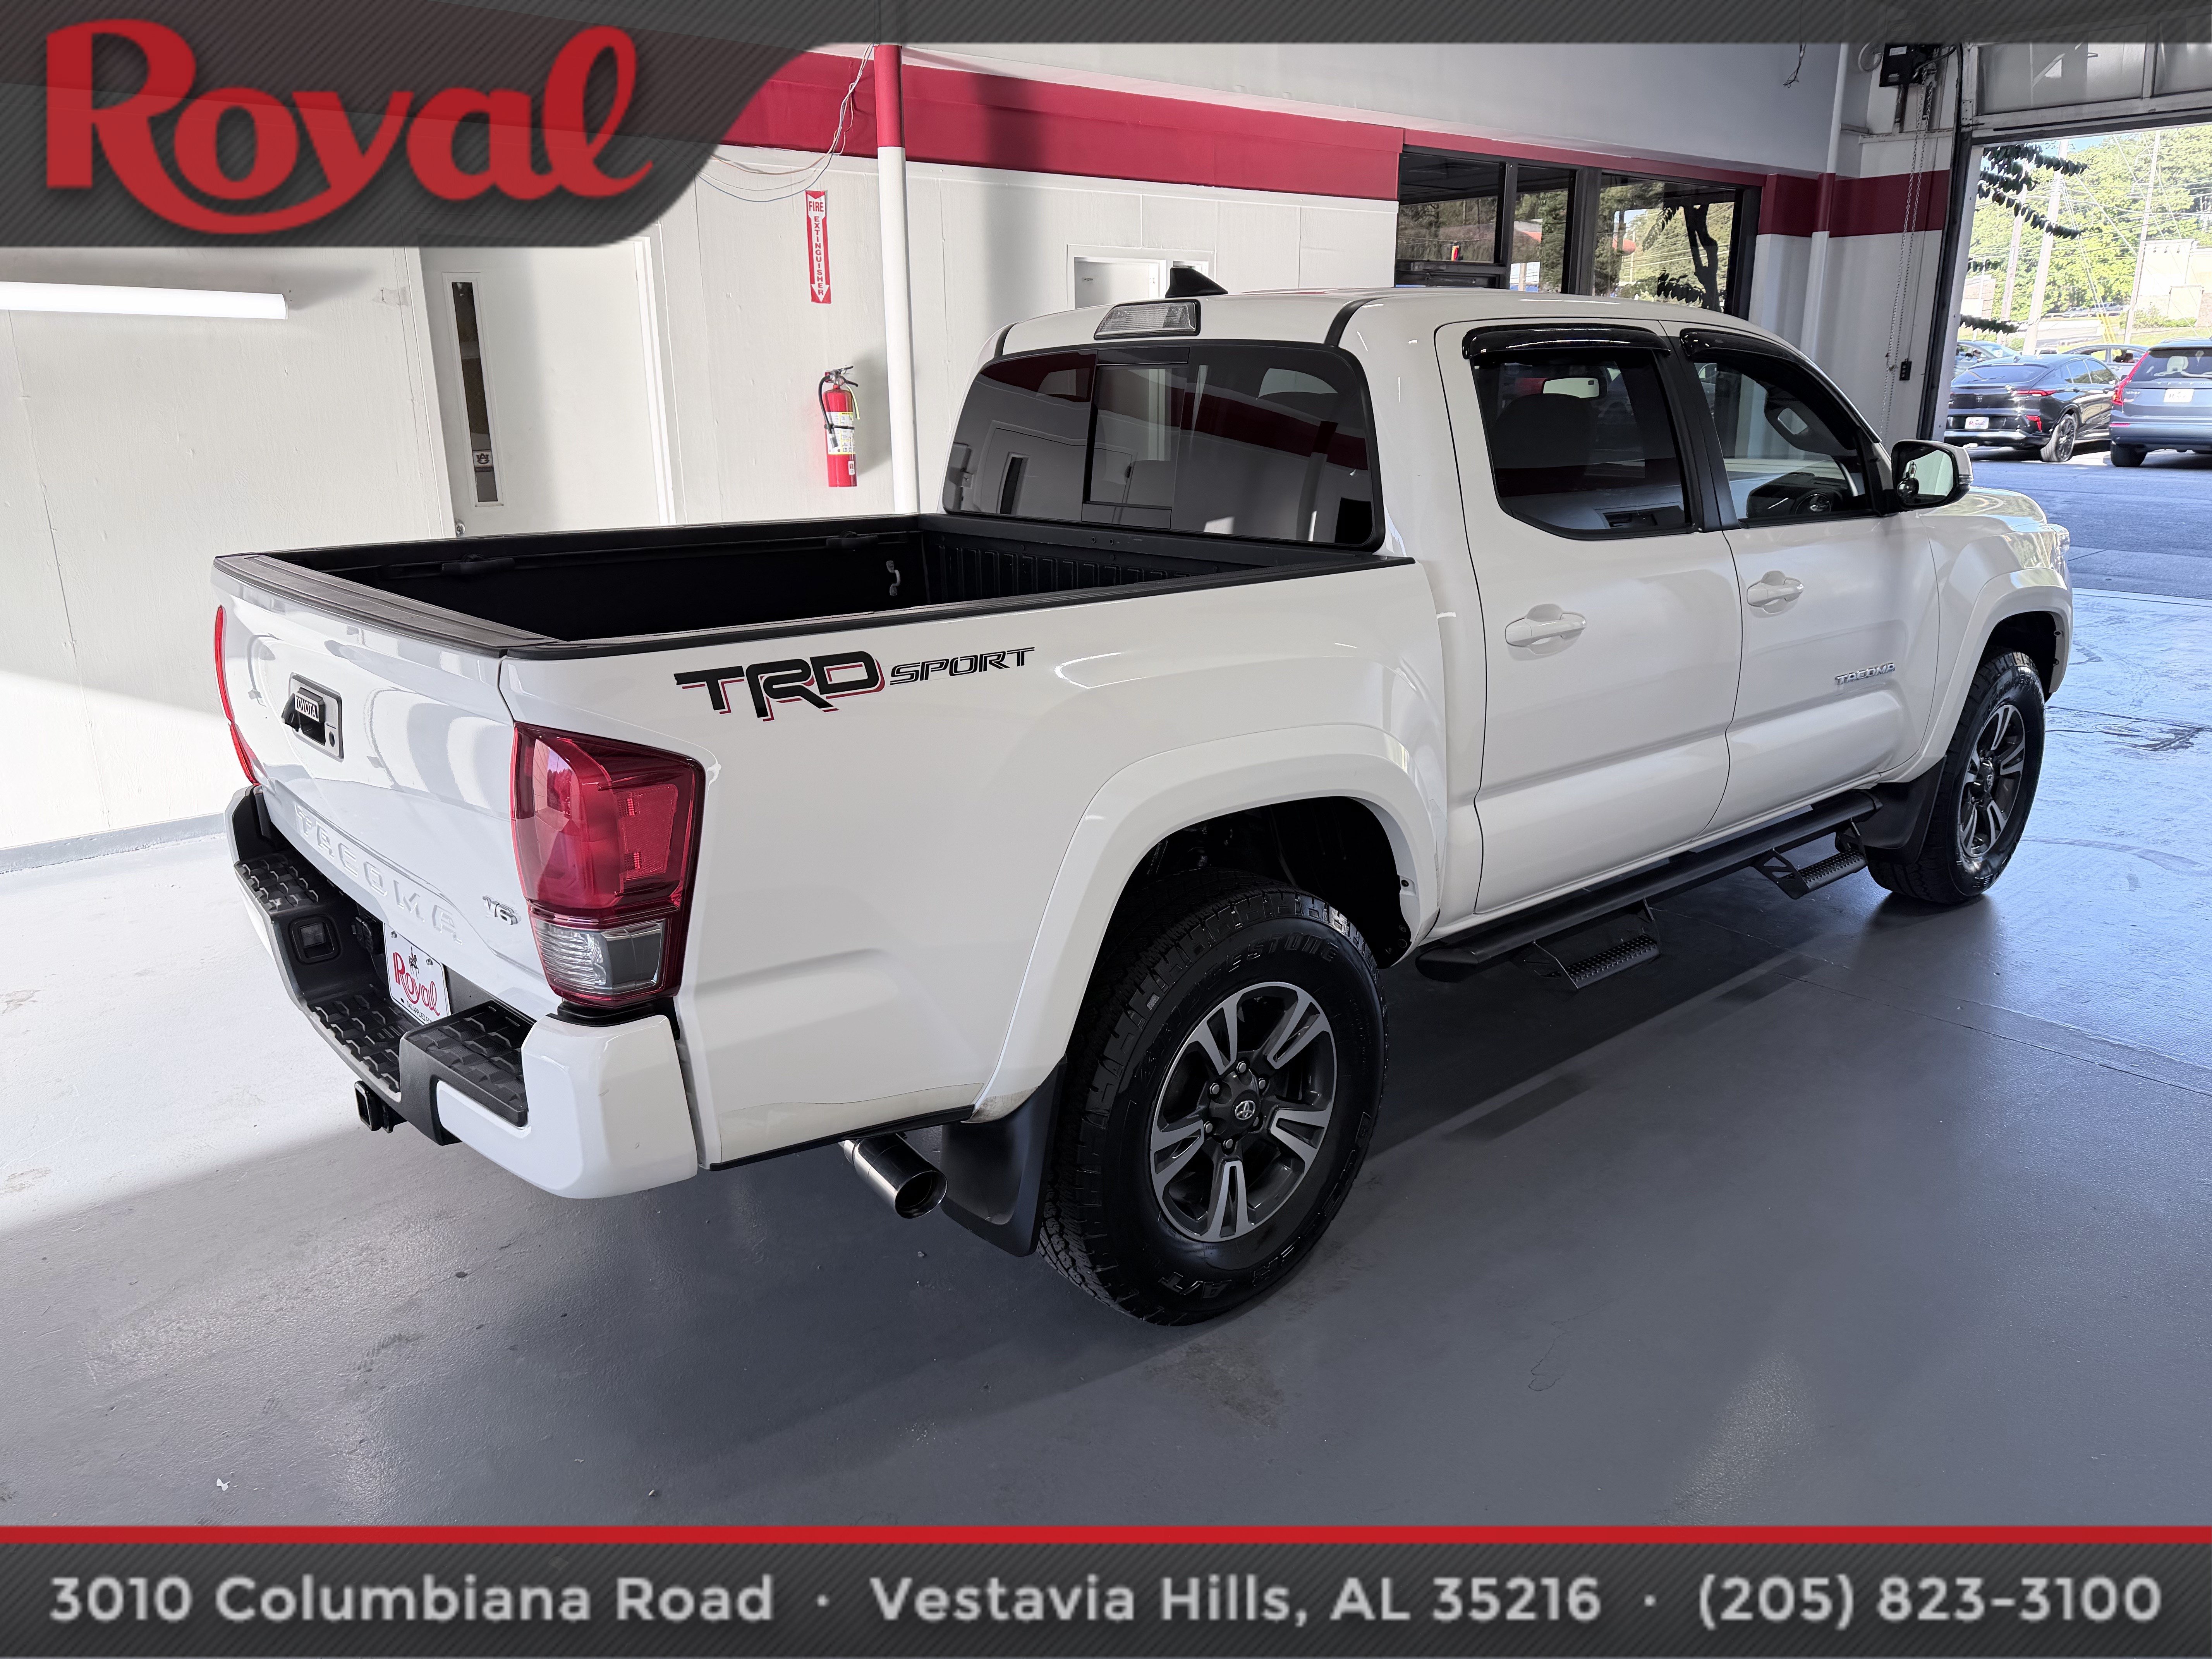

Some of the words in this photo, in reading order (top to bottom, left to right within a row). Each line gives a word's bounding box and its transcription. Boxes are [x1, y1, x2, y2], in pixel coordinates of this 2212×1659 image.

[809, 201, 824, 212] FIRE
[814, 216, 824, 295] EXTINGUISHER
[674, 651, 886, 721] TRD
[890, 647, 1035, 686] SPORT
[1834, 663, 1895, 685] TACOMA
[295, 696, 319, 719] TOYOTA
[294, 804, 463, 946] TACOMA
[482, 895, 519, 925] V6
[393, 952, 441, 1016] Royal
[1156, 1271, 1233, 1299] A/T
